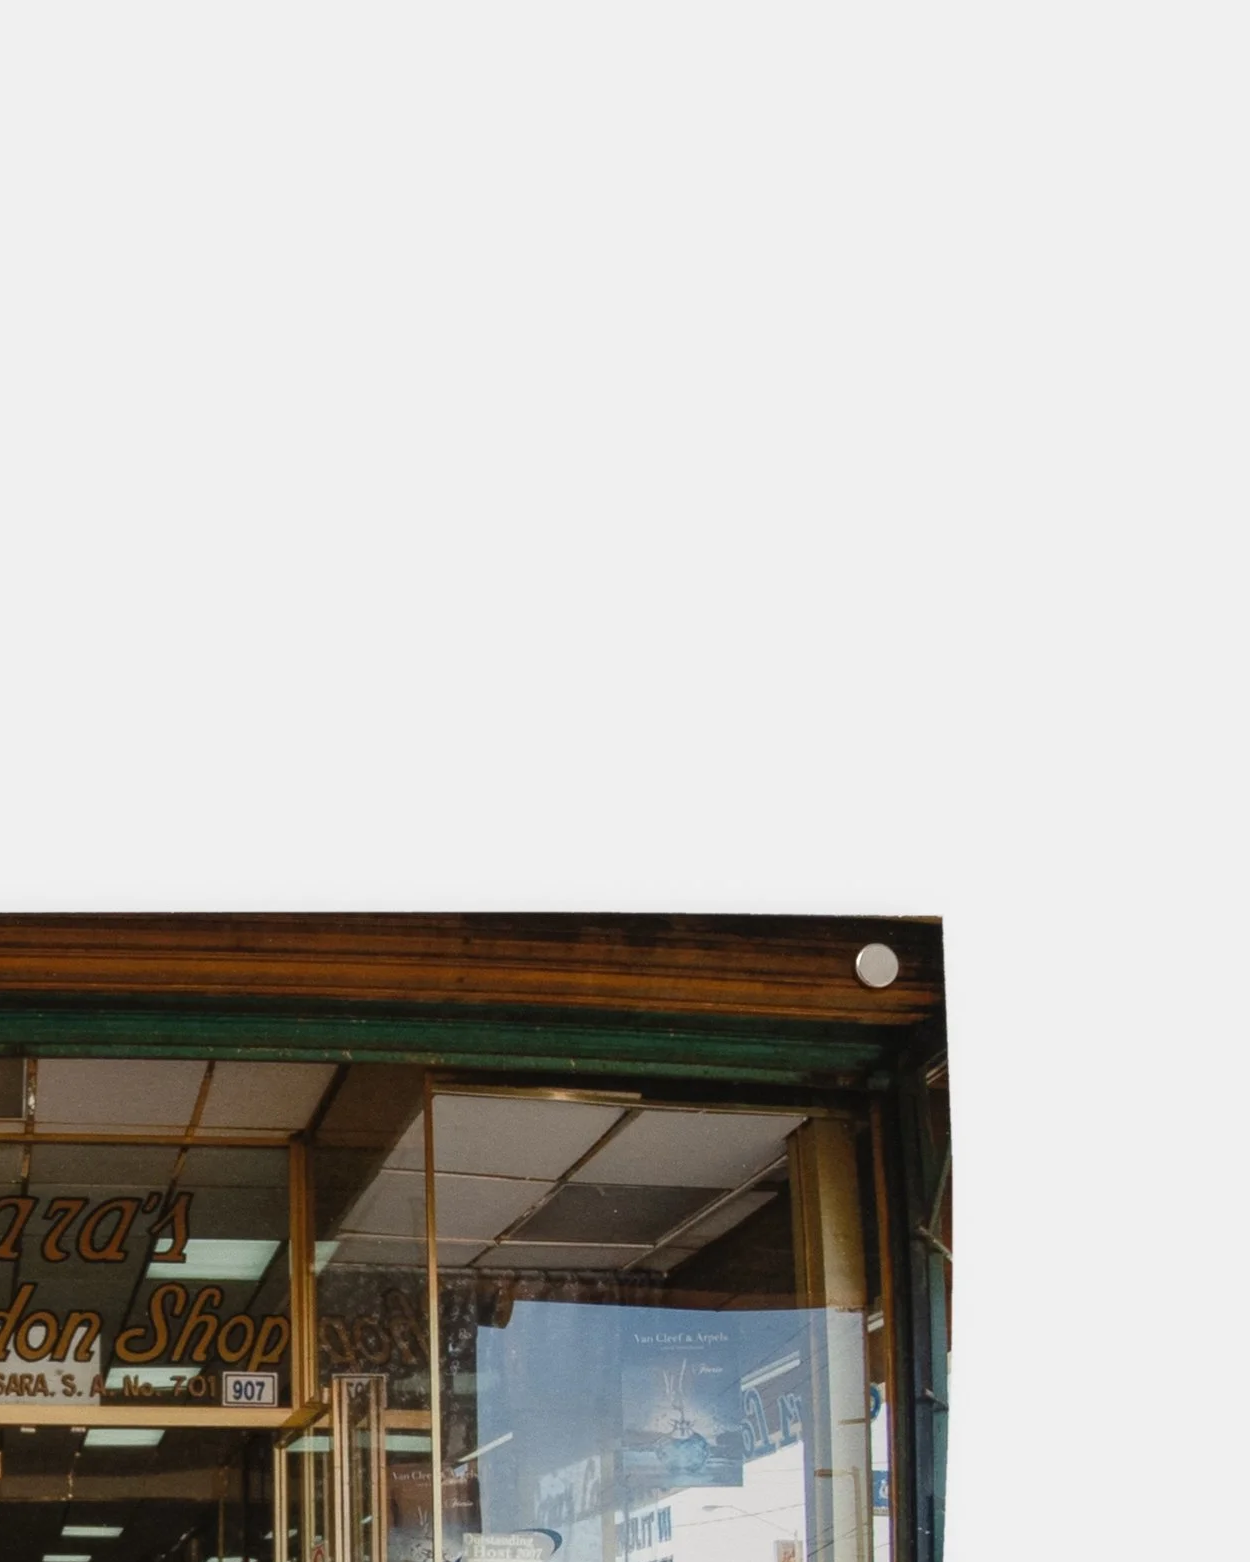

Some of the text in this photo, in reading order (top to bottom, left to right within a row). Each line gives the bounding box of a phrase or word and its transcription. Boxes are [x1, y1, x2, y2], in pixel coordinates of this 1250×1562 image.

[114, 1282, 291, 1371] Shop
[231, 1379, 267, 1402] 907
[411, 1470, 434, 1481] Clee
[463, 1532, 534, 1547] Outstanding
[474, 1546, 511, 1559] Host
